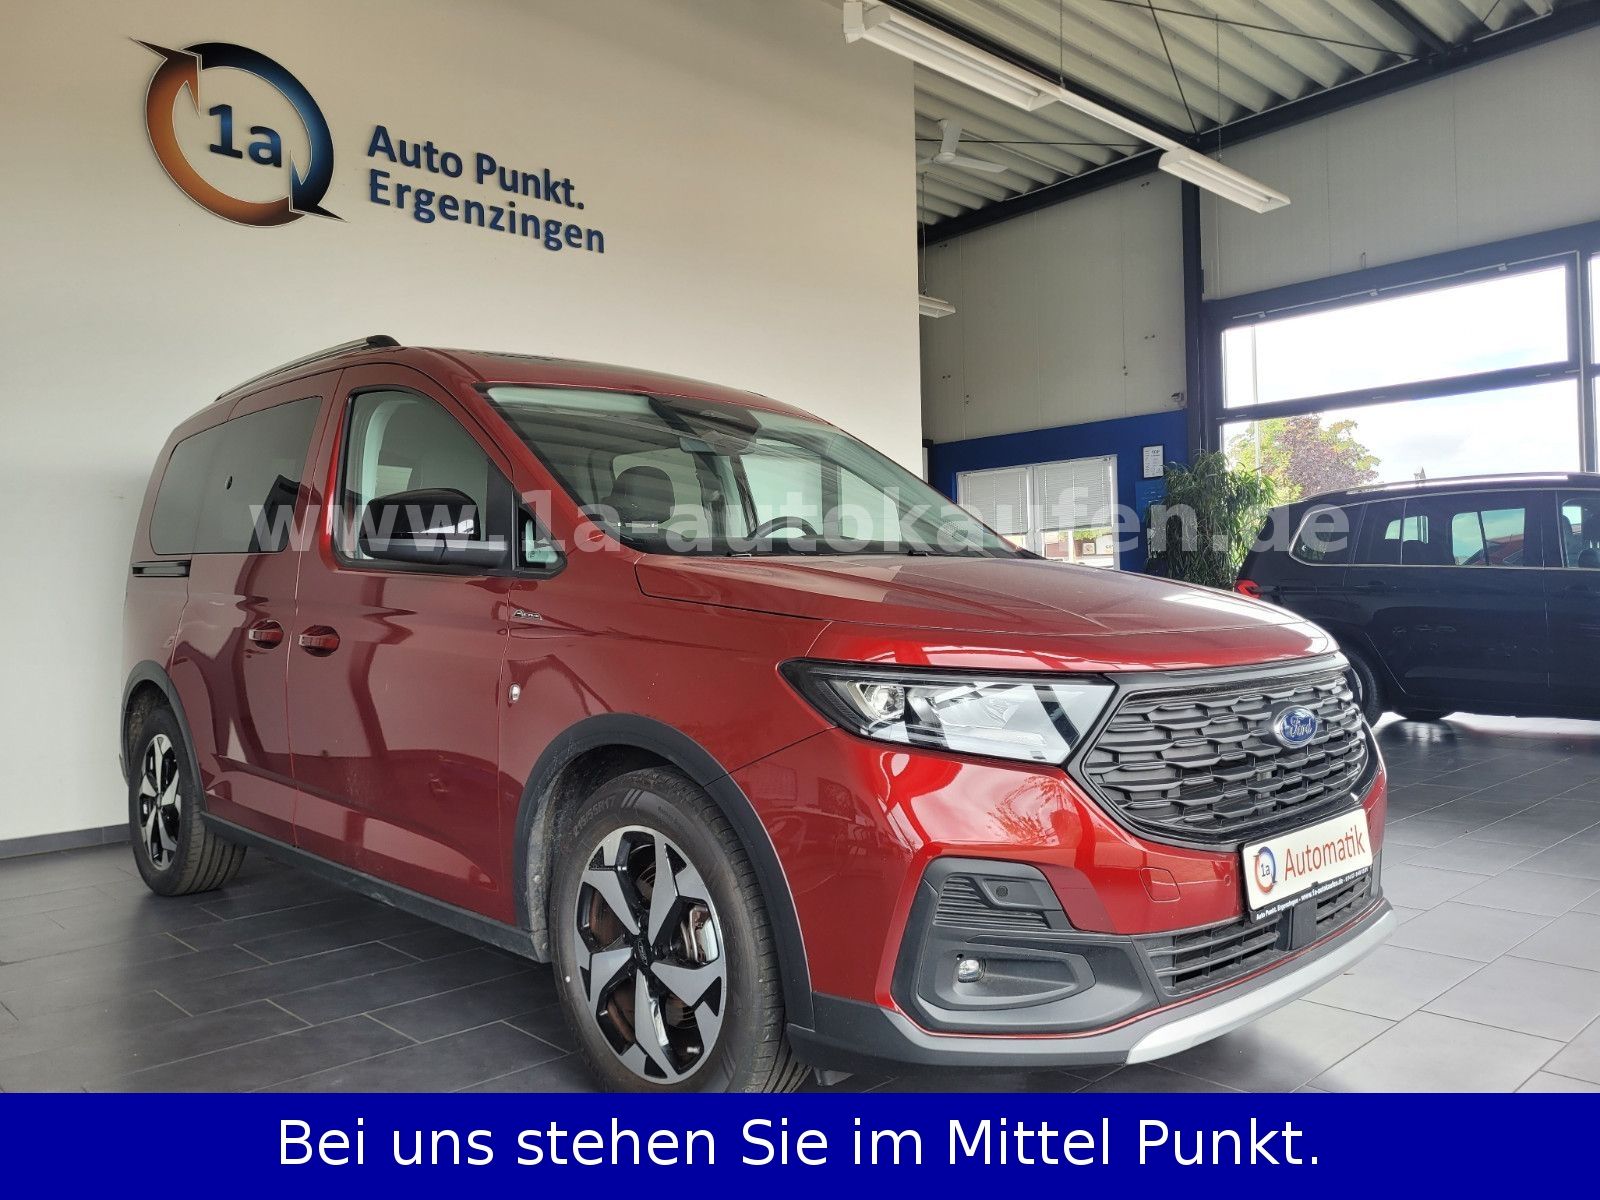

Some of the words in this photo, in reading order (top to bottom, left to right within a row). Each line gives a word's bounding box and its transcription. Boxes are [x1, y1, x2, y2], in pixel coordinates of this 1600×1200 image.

[208, 103, 282, 168] 1a
[367, 124, 463, 178] Auto
[475, 152, 585, 210] Punkt.
[369, 168, 606, 254] Ergenzingen
[1288, 715, 1313, 738] Ford
[1285, 826, 1365, 880] Automatik
